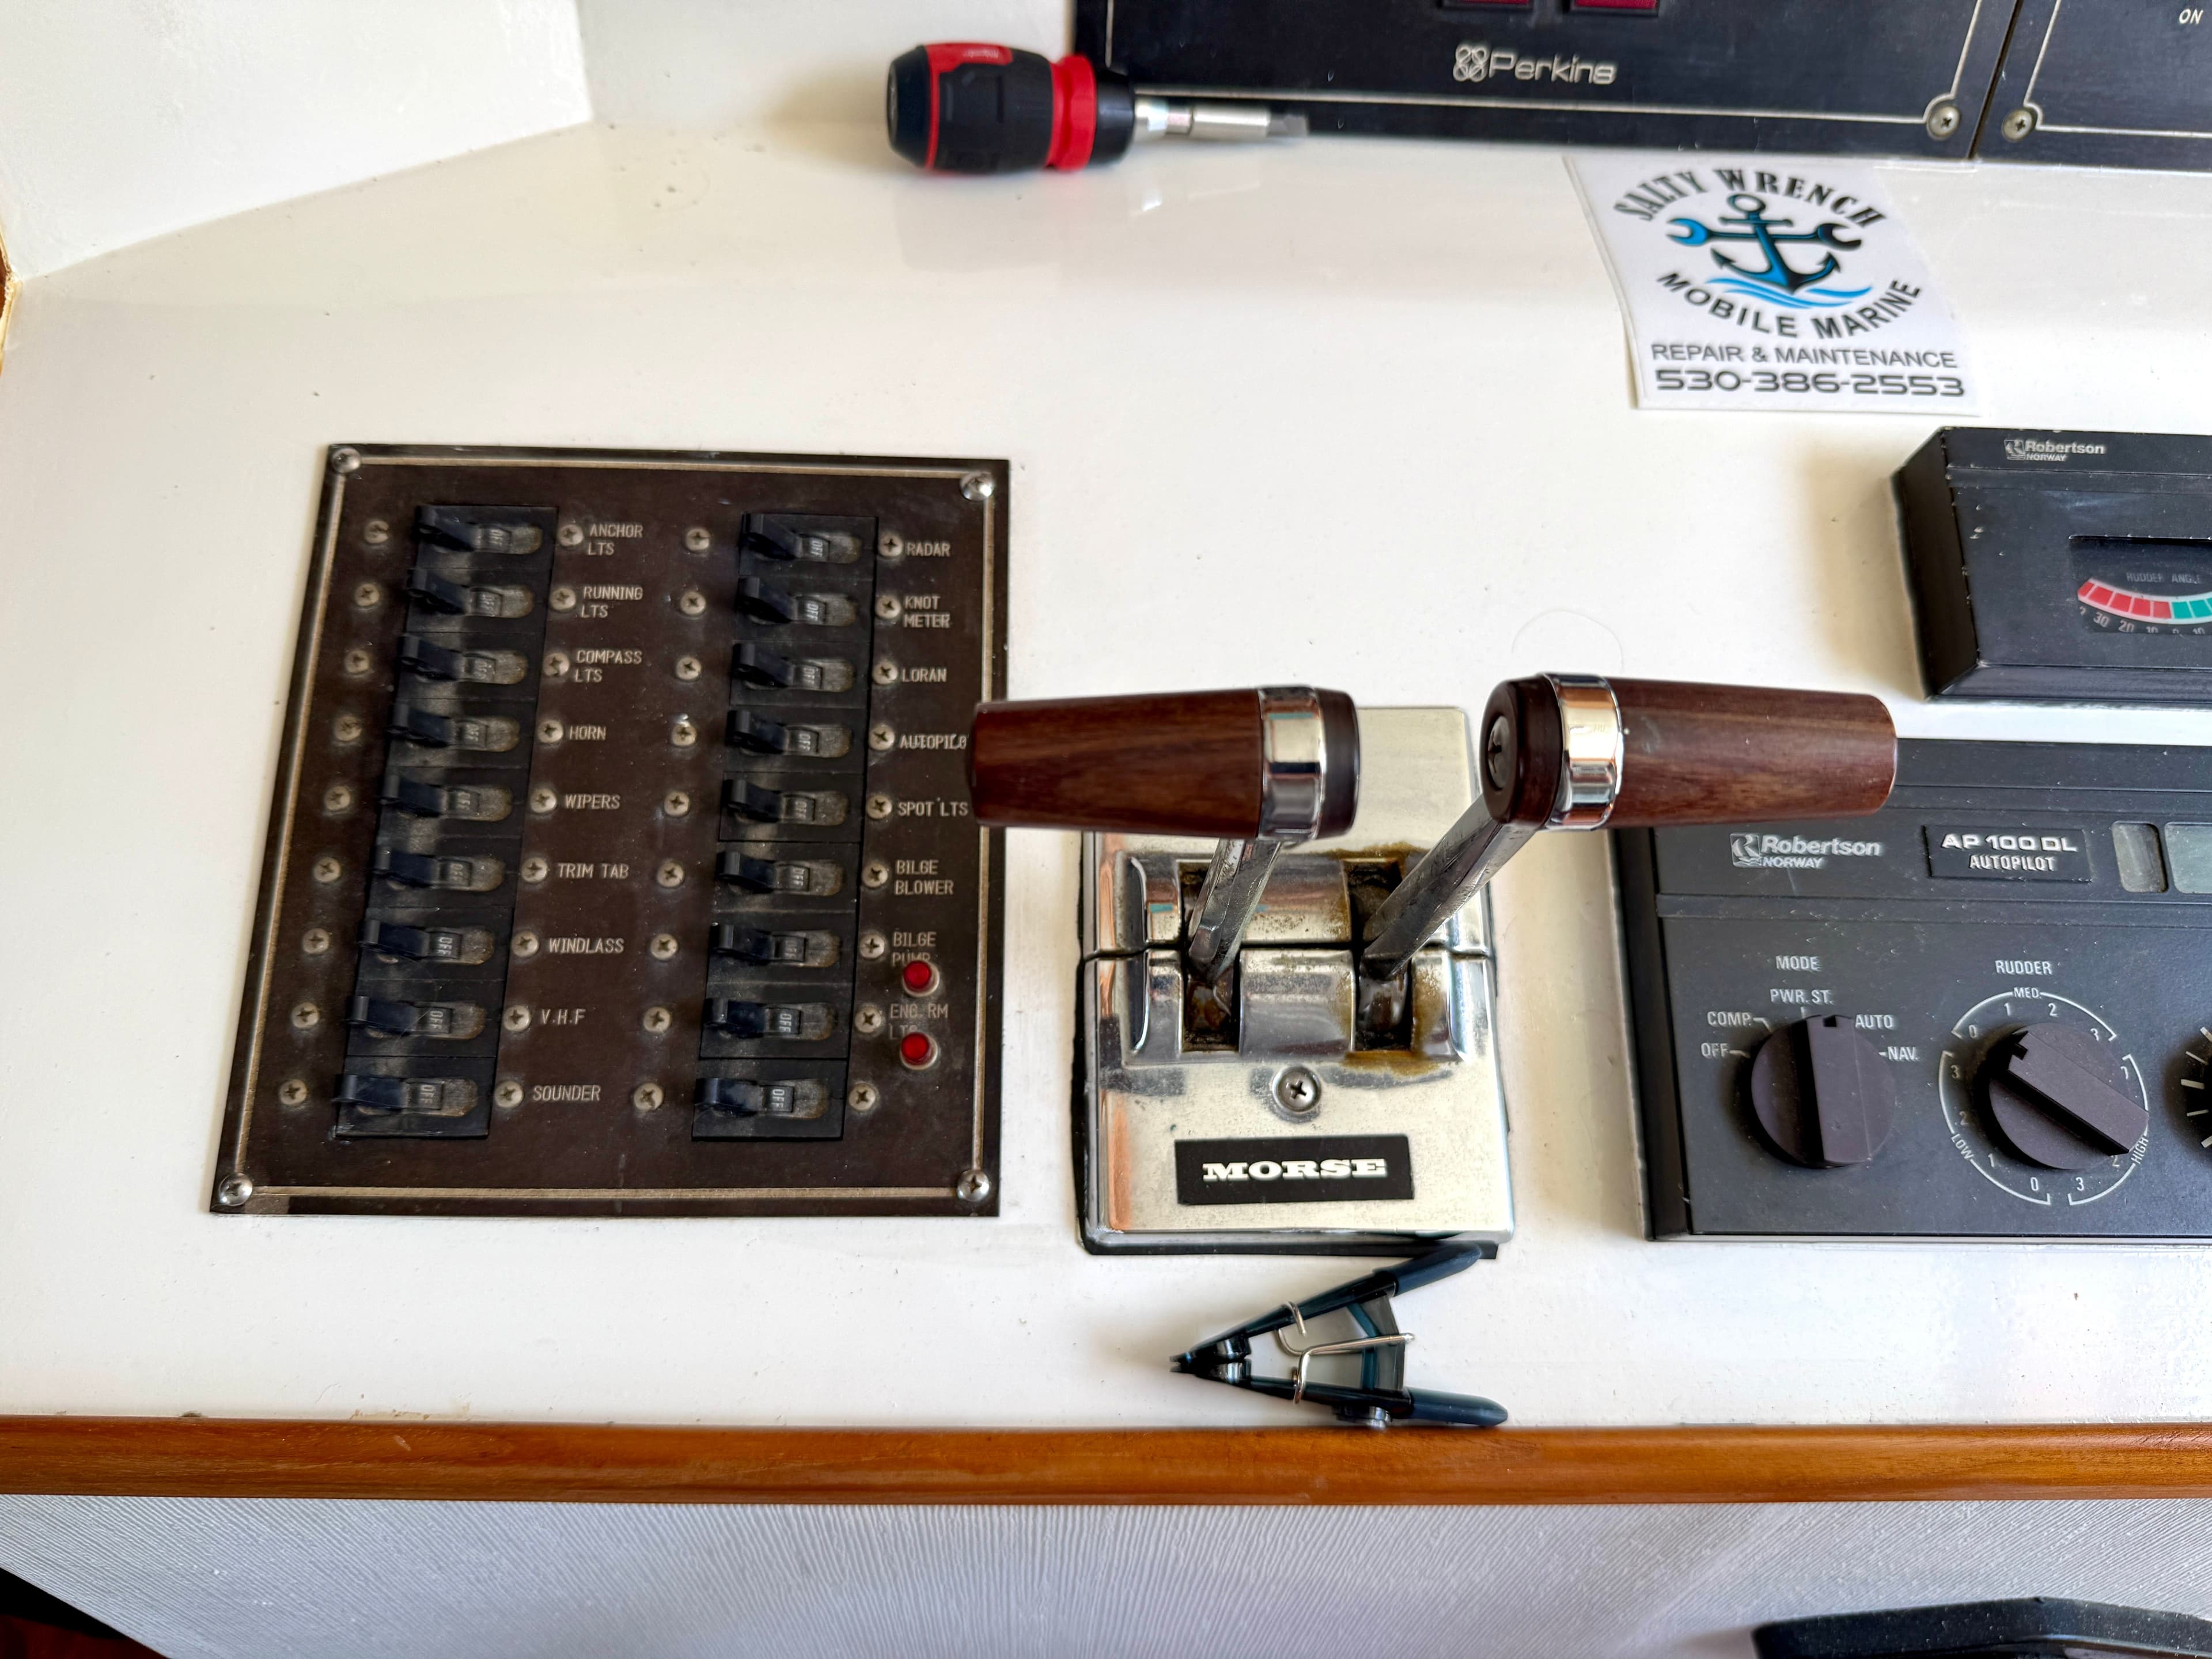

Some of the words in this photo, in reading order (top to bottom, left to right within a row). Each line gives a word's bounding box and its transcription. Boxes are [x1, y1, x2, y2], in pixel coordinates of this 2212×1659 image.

[2179, 8, 2204, 25] ON
[1489, 51, 1618, 85] Perkins
[1613, 172, 1708, 222] SALTY
[1713, 168, 1886, 228] WRENCH
[1657, 272, 1799, 338] MOBILE
[1811, 279, 1922, 339] MARINE
[1652, 344, 1744, 362] REPAIR
[1751, 347, 1768, 363] &
[1775, 347, 1958, 369] MAINTENANCE
[1656, 369, 1965, 397] 530-386-2553
[2025, 440, 2106, 454] Robertson
[2026, 452, 2067, 461] NORWAY
[590, 523, 643, 538] ANCHOR
[588, 541, 615, 556] LTS
[810, 540, 823, 558] OFF
[907, 543, 950, 556] RADAR
[583, 585, 643, 600] RUNNING
[905, 596, 940, 609] KNOT
[581, 604, 608, 618] LTS
[806, 603, 819, 621] OFF
[904, 614, 950, 628] METER
[2093, 612, 2110, 627] 30
[577, 649, 643, 664] COMPASS
[575, 668, 603, 683] LTS
[902, 668, 947, 683] LORAN
[569, 725, 607, 740] HORN
[798, 732, 812, 751] OFF
[900, 734, 969, 749] AUTOPILO
[565, 794, 620, 809] WIPERS
[898, 801, 934, 816] SPOT
[940, 801, 968, 816] LTS
[1761, 835, 1885, 857] Robertson
[1941, 834, 1982, 849] AP
[1985, 835, 2036, 851] 100
[2040, 836, 2078, 852] DL
[896, 860, 938, 875] BILGE
[1763, 857, 1825, 868] NORWAY
[1969, 855, 2056, 872] AUTOPILOT
[558, 863, 594, 878] TRIM
[601, 863, 629, 879] TAB
[791, 866, 805, 887] OFF
[895, 880, 954, 895] BLOWER
[438, 936, 453, 956] OFF
[549, 938, 624, 953] WINDLASS
[893, 931, 937, 946] BILGE
[1775, 956, 1820, 971] MODE
[1995, 960, 2052, 975] RUDDER
[1770, 988, 1808, 1004] PWR.
[1811, 990, 1835, 1004] ST.
[2013, 987, 2041, 999] MED.
[541, 1009, 586, 1025] V.H.F
[928, 1003, 949, 1019] RM
[430, 1010, 444, 1031] OFF
[778, 1013, 792, 1033] OFF
[1707, 1011, 1752, 1027] COMP.
[1855, 1014, 1894, 1029] AUTO
[1968, 1025, 1977, 1038] 0
[2003, 1002, 2011, 1016] 1
[2048, 1003, 2058, 1018] 2
[1700, 1043, 1730, 1059] OFF
[1887, 1046, 1919, 1061] NAV.
[1950, 1065, 1960, 1079] 3
[533, 1085, 601, 1101] SOUNDER
[771, 1088, 785, 1108] OFF
[1959, 1111, 1968, 1125] 2
[1950, 1133, 1974, 1160] LOW
[2131, 1135, 2149, 1165] HIGH
[1988, 1153, 1995, 1168] 1
[1203, 1158, 1387, 1181] MORSE
[2031, 1176, 2039, 1191] 0
[2075, 1176, 2085, 1191] 3
